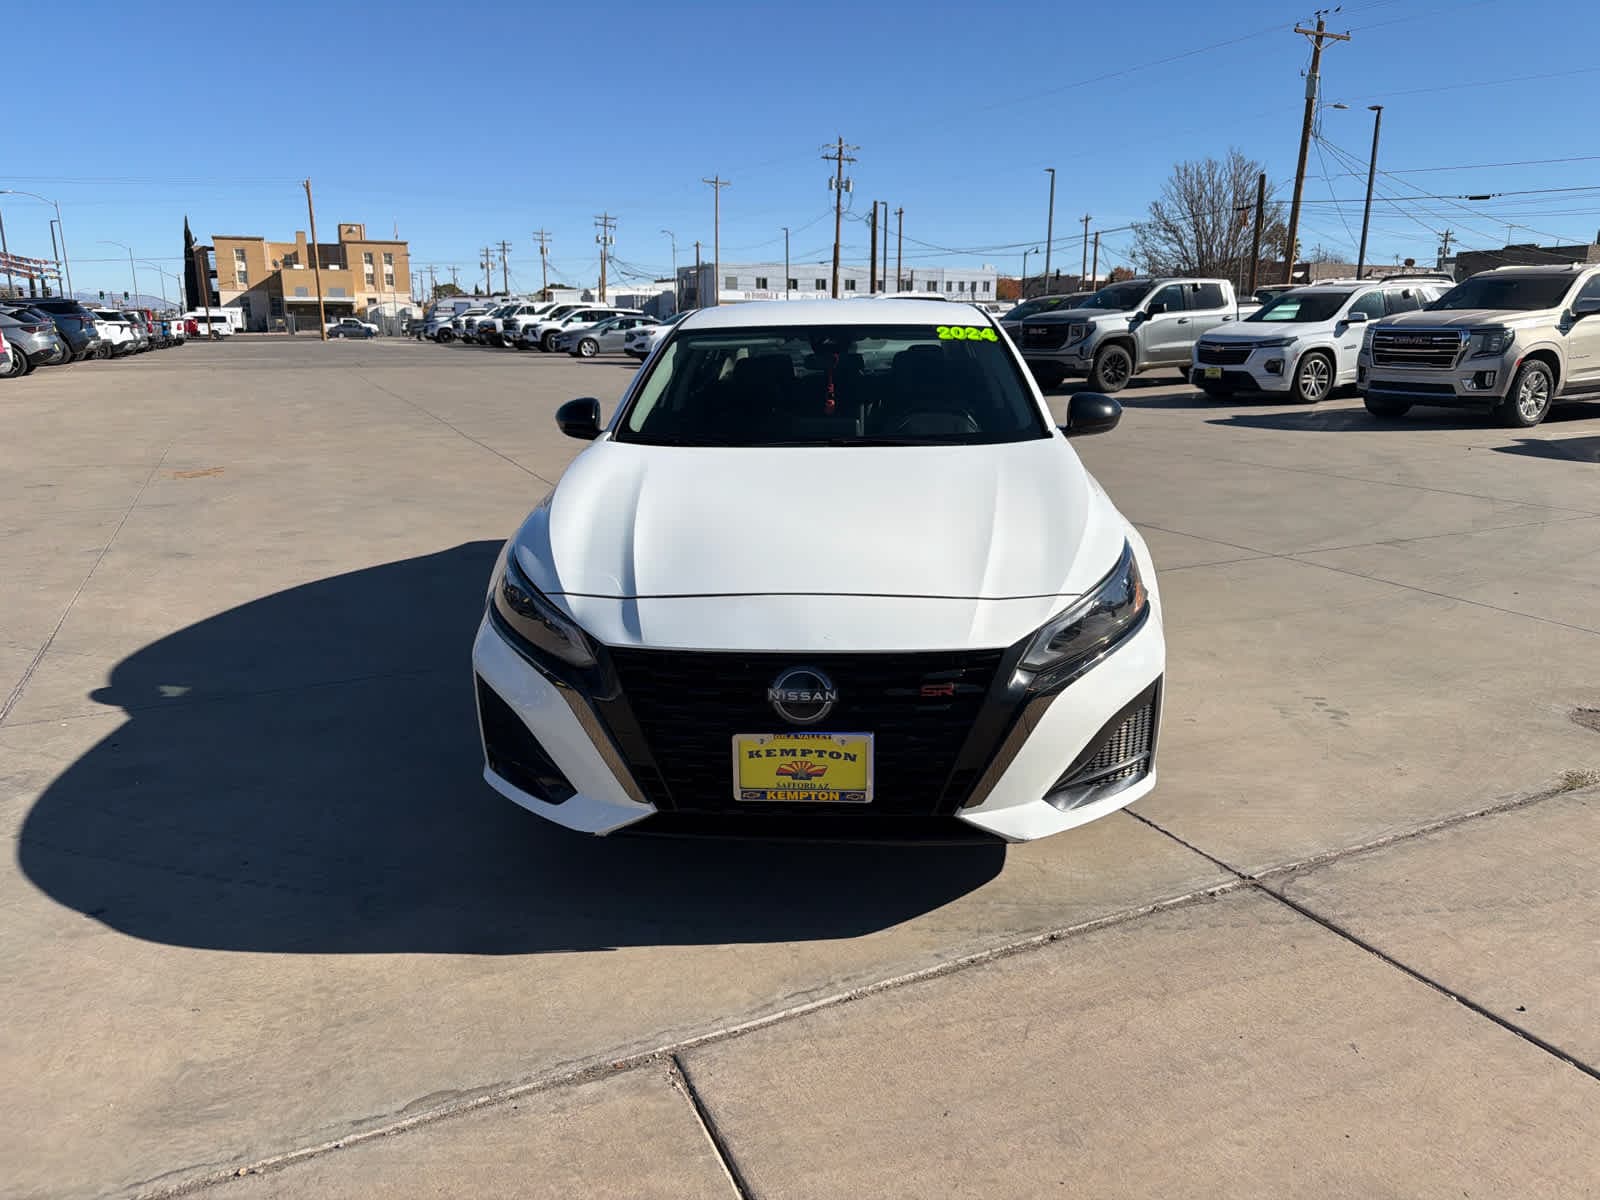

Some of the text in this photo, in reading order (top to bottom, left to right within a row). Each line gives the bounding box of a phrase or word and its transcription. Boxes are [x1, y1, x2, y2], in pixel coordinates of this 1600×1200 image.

[936, 326, 998, 342] 2024
[1394, 335, 1432, 345] GMC
[768, 688, 837, 701] NISSAN
[748, 748, 858, 763] KEMPTON
[766, 791, 840, 801] KEMPTON
